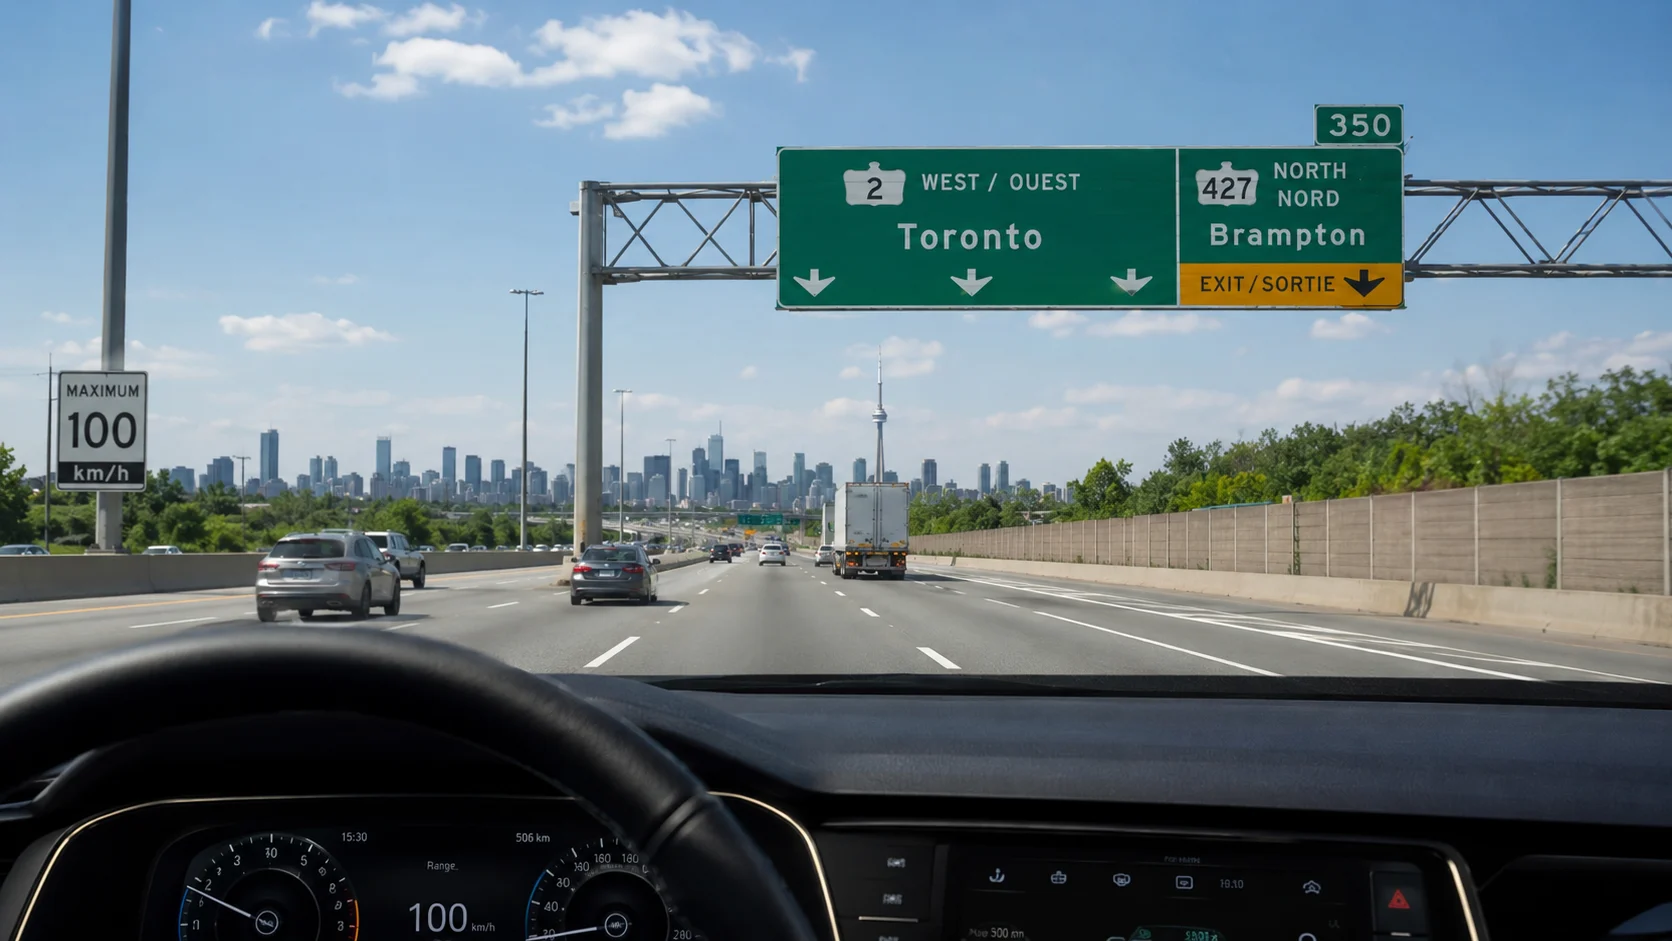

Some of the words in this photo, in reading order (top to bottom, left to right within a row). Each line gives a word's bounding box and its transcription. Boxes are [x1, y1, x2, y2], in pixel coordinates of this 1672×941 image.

[1329, 113, 1391, 137] 350
[1273, 161, 1347, 181] NORTH
[865, 177, 884, 201] 2
[921, 172, 980, 192] WEST
[1009, 172, 1081, 192] OUEST
[1201, 176, 1252, 201] 427
[1277, 189, 1341, 208] NORD
[896, 222, 1043, 251] Toronto
[1209, 223, 1366, 252] Brampton
[66, 384, 139, 398] MAXIMUM
[67, 411, 138, 449] 100
[73, 464, 129, 482] km/h
[341, 832, 368, 842] 15:30
[515, 832, 534, 843] 506
[536, 832, 551, 843] km
[300, 854, 308, 867] 5
[543, 901, 559, 912] 40
[408, 902, 469, 933] 100
[471, 922, 496, 933] km/h
